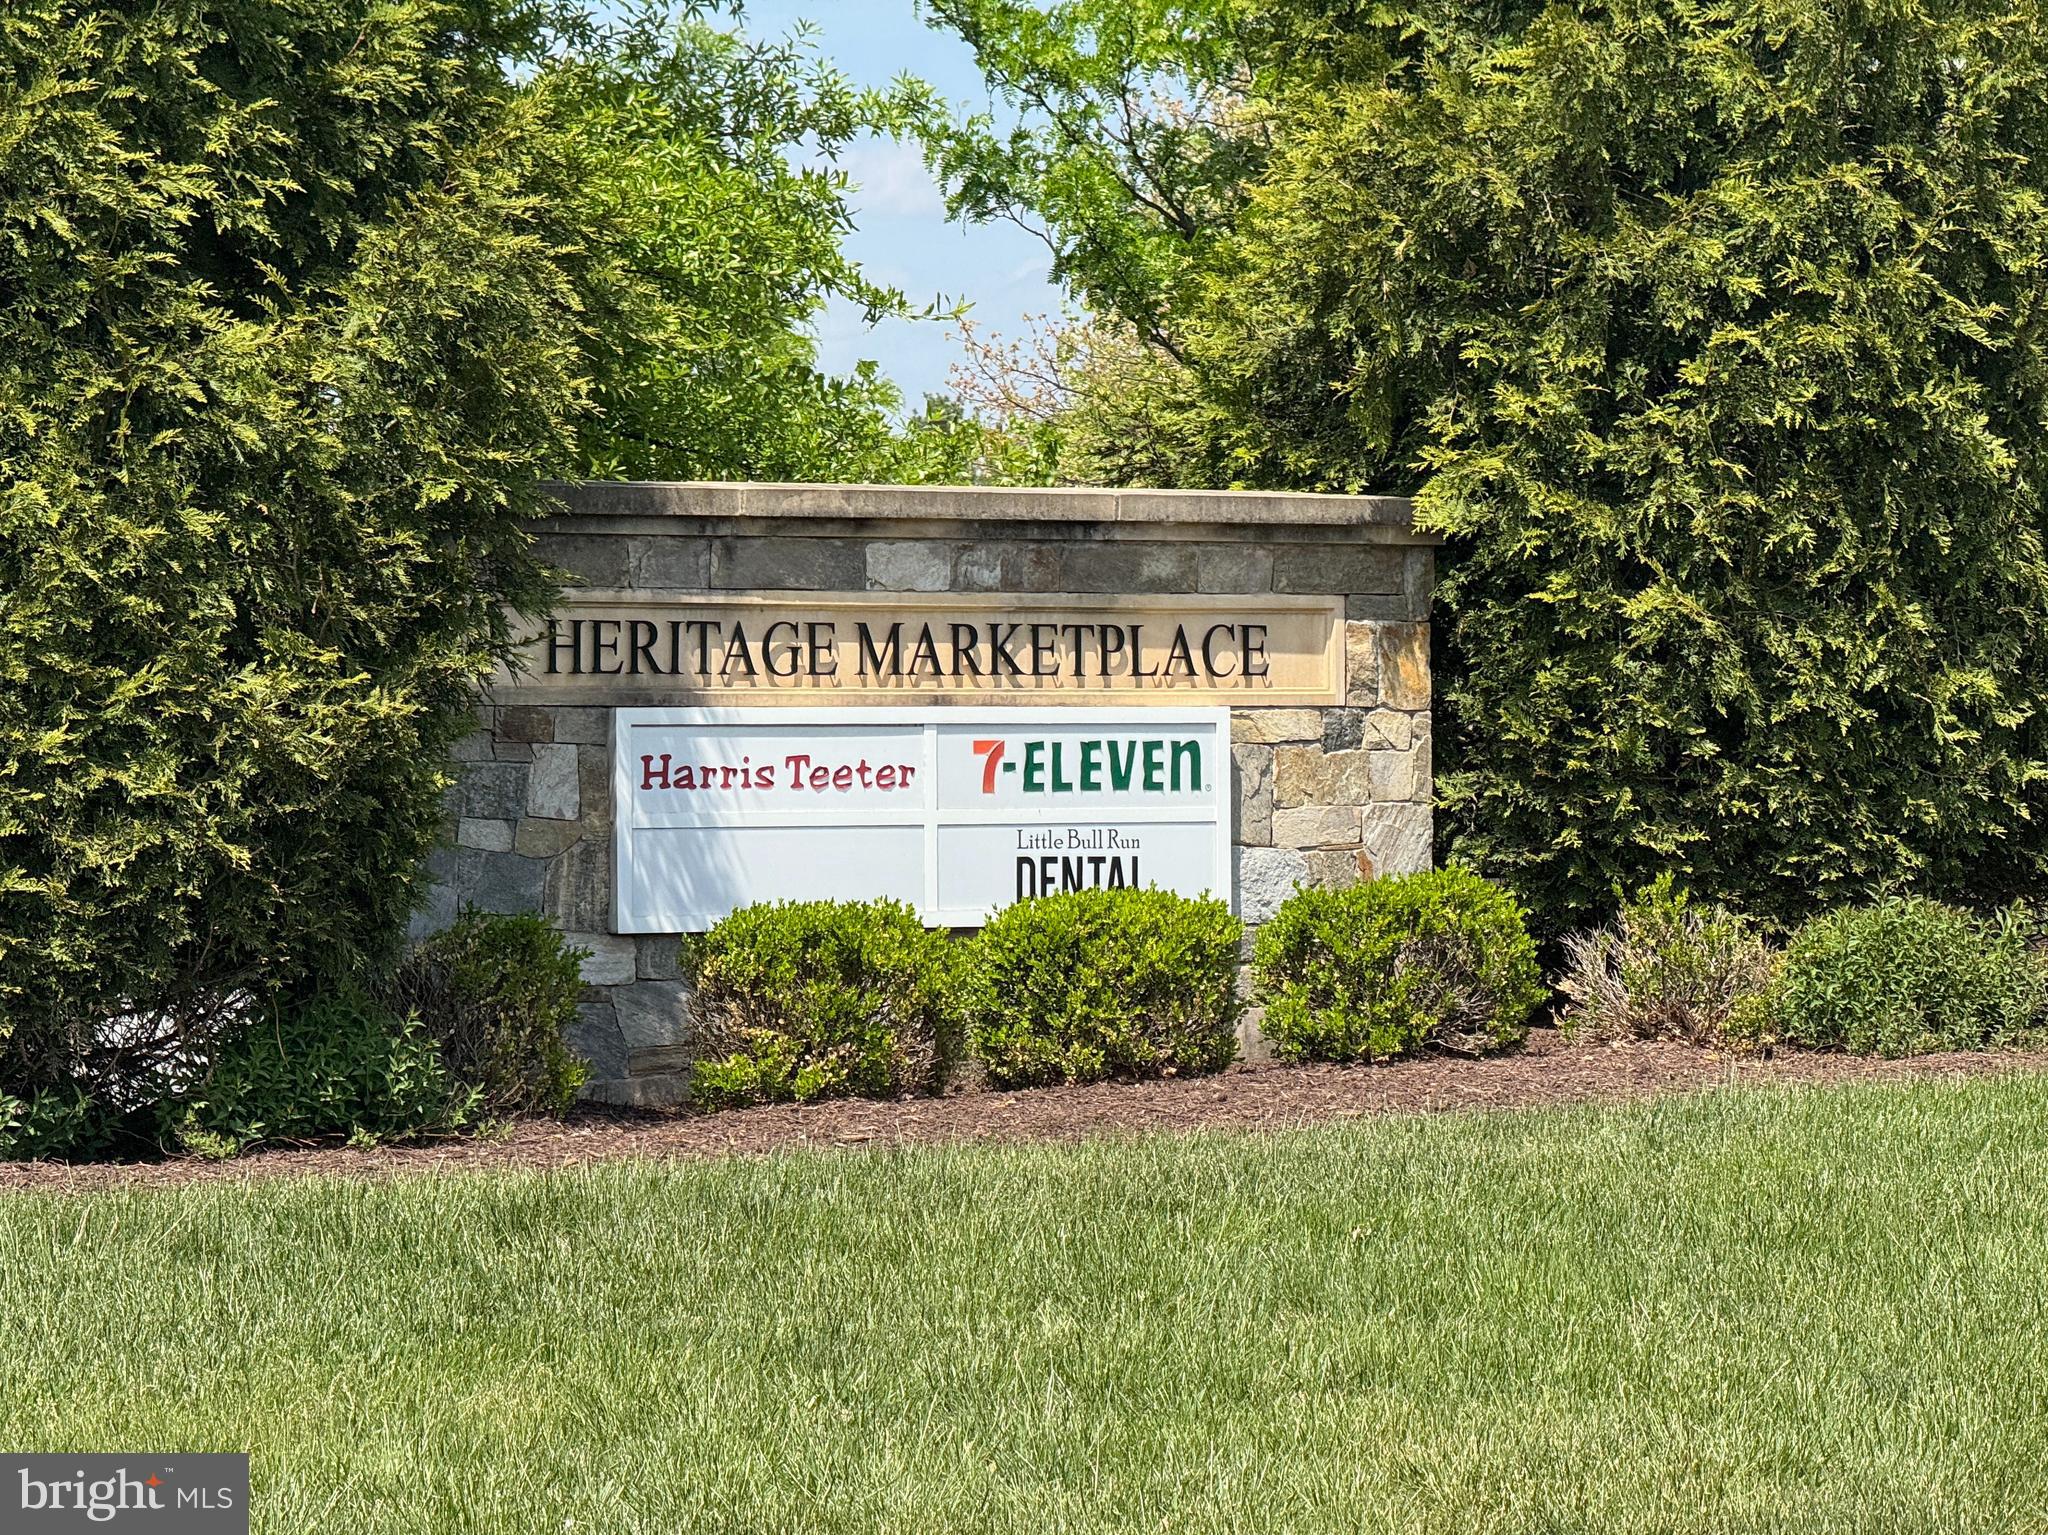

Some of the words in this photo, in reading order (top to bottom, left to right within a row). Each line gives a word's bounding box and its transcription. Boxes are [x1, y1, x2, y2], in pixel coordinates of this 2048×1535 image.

[544, 619, 839, 677] HERITAGE
[853, 621, 1270, 678] MARKETPLACE
[639, 753, 775, 791] Harris
[784, 754, 916, 792] Teeter
[1016, 828, 1064, 850] Little
[1067, 828, 1104, 849] Bull
[1106, 828, 1140, 849] Run
